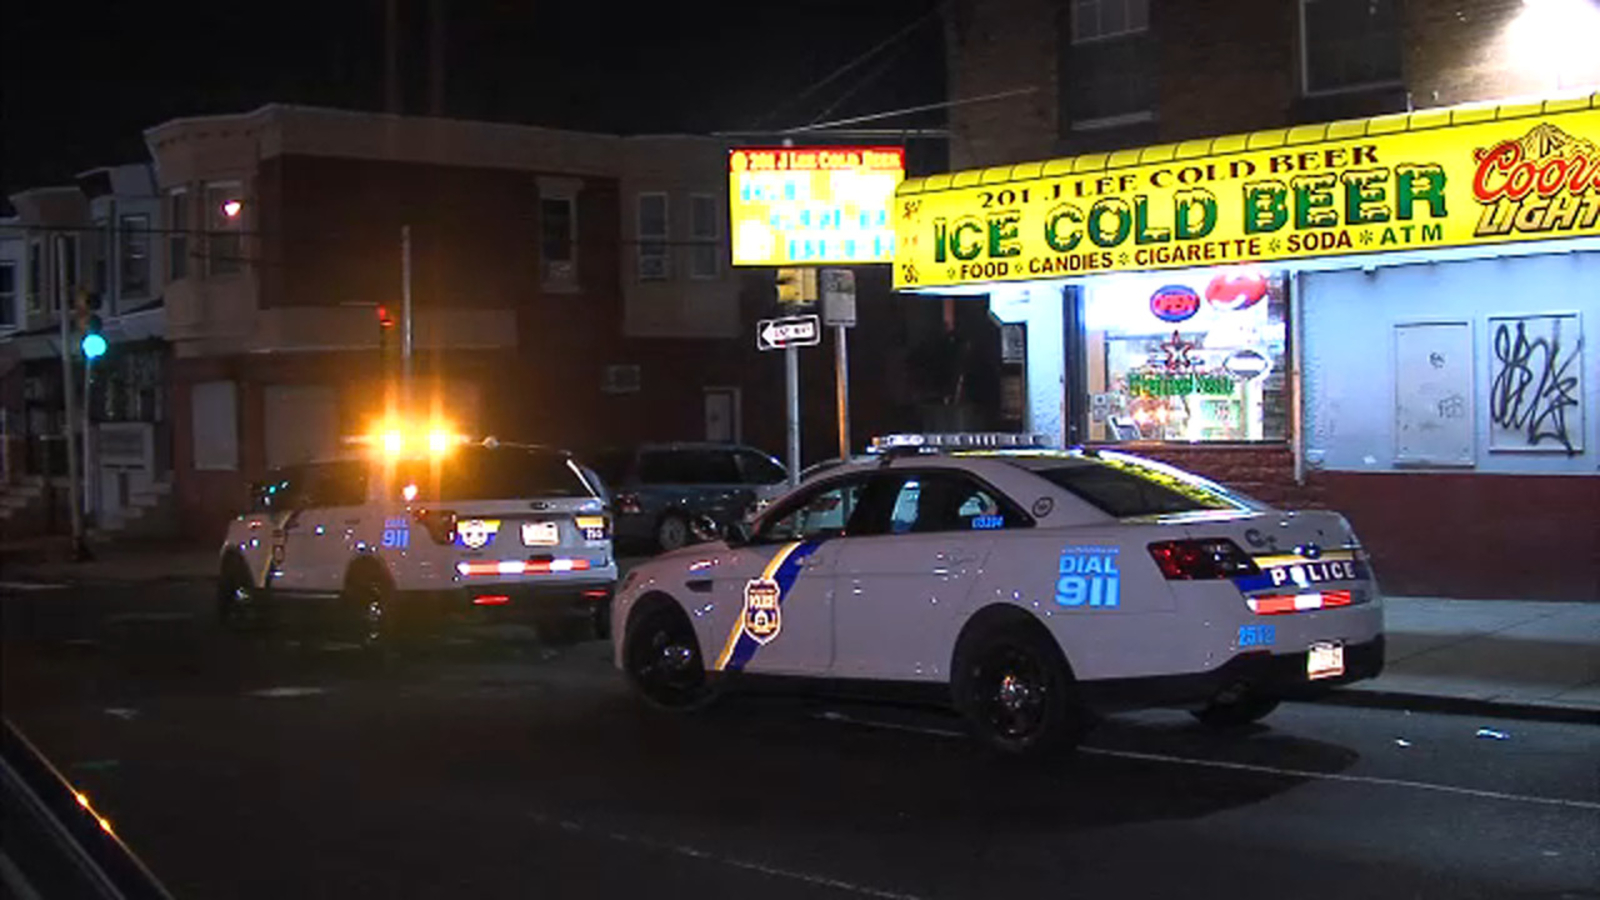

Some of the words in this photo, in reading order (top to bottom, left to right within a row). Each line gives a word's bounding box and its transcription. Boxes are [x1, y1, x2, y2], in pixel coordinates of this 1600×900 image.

[977, 188, 1030, 208] 201
[1044, 184, 1061, 200] J
[1075, 174, 1138, 198] LEE
[1149, 160, 1256, 188] COLD
[1269, 145, 1379, 174] BEER
[933, 209, 1021, 263] ICE
[1045, 187, 1218, 253] COLD
[1242, 163, 1448, 235] BEER
[960, 262, 1009, 280] FOOD
[1029, 251, 1113, 274] CANDIES
[1134, 237, 1261, 266] CIGARETTE
[1287, 230, 1353, 253] SODA
[1380, 223, 1443, 246] ATM
[381, 529, 410, 548] 911
[1059, 555, 1118, 574] DIAL
[1270, 561, 1355, 586] POLICE
[1055, 575, 1119, 606] 911
